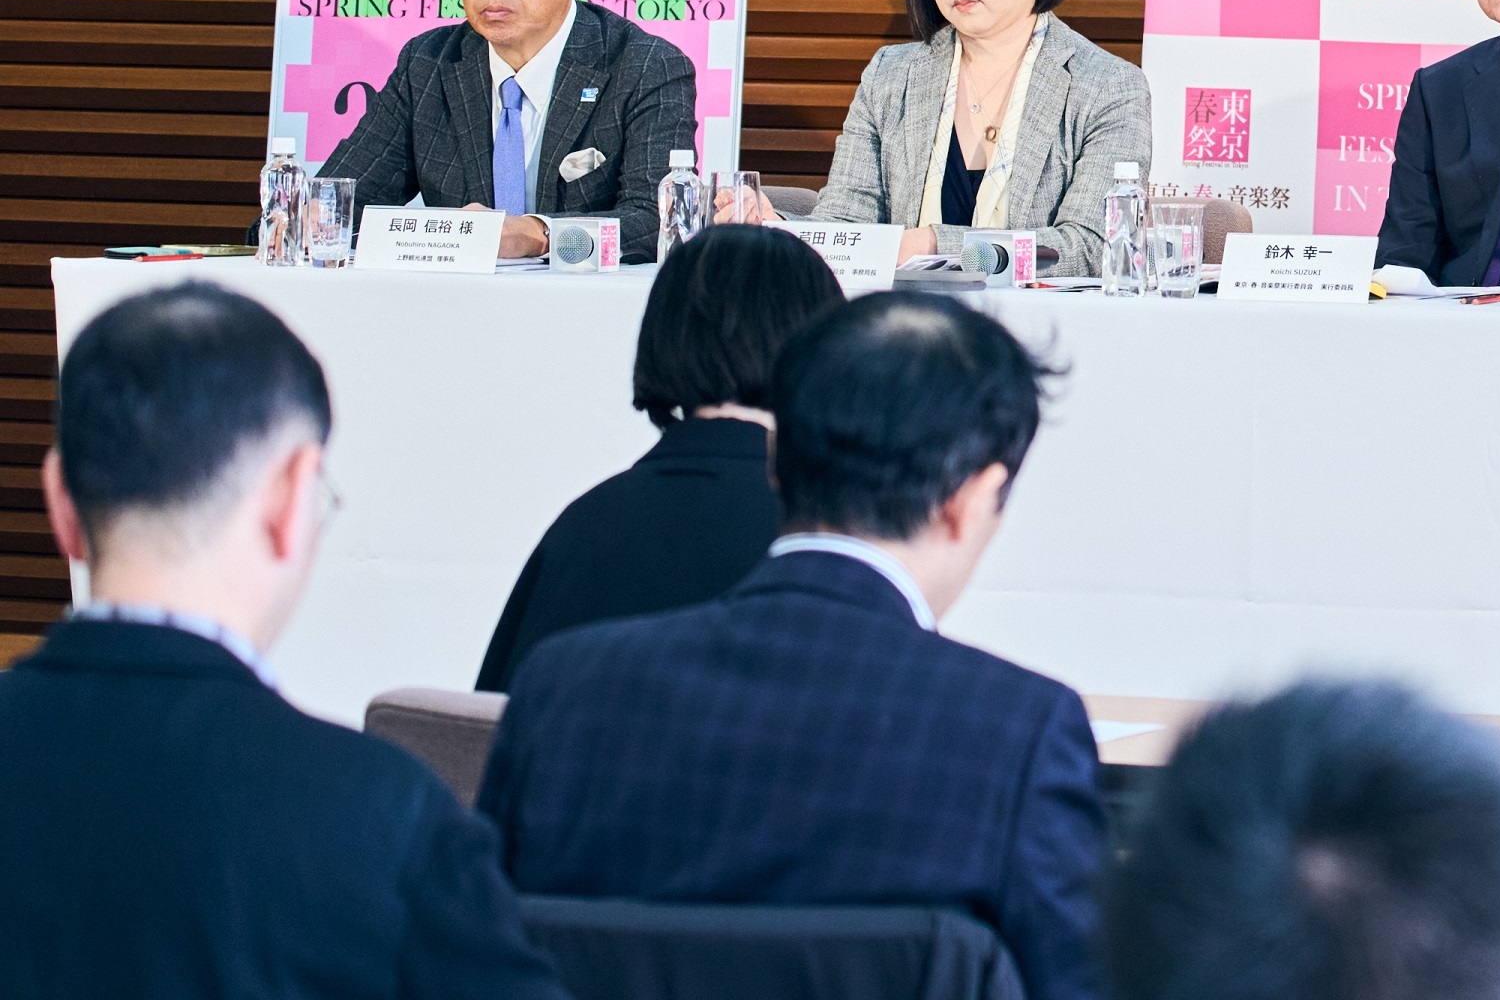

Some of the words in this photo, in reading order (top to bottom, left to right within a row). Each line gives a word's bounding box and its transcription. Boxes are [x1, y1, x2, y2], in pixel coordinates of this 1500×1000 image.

[622, 0, 727, 21] TOKYO
[1333, 184, 1369, 212] IN
[388, 218, 417, 233] 長岡
[424, 219, 452, 234] 信裕
[459, 221, 474, 235] 様
[395, 241, 426, 249] Nobuhiro
[833, 231, 862, 247] 尚子
[824, 254, 851, 262] ASHIDA
[1264, 244, 1295, 260] 鈴木
[1302, 245, 1333, 260] 幸一
[1270, 268, 1292, 276] Koichi
